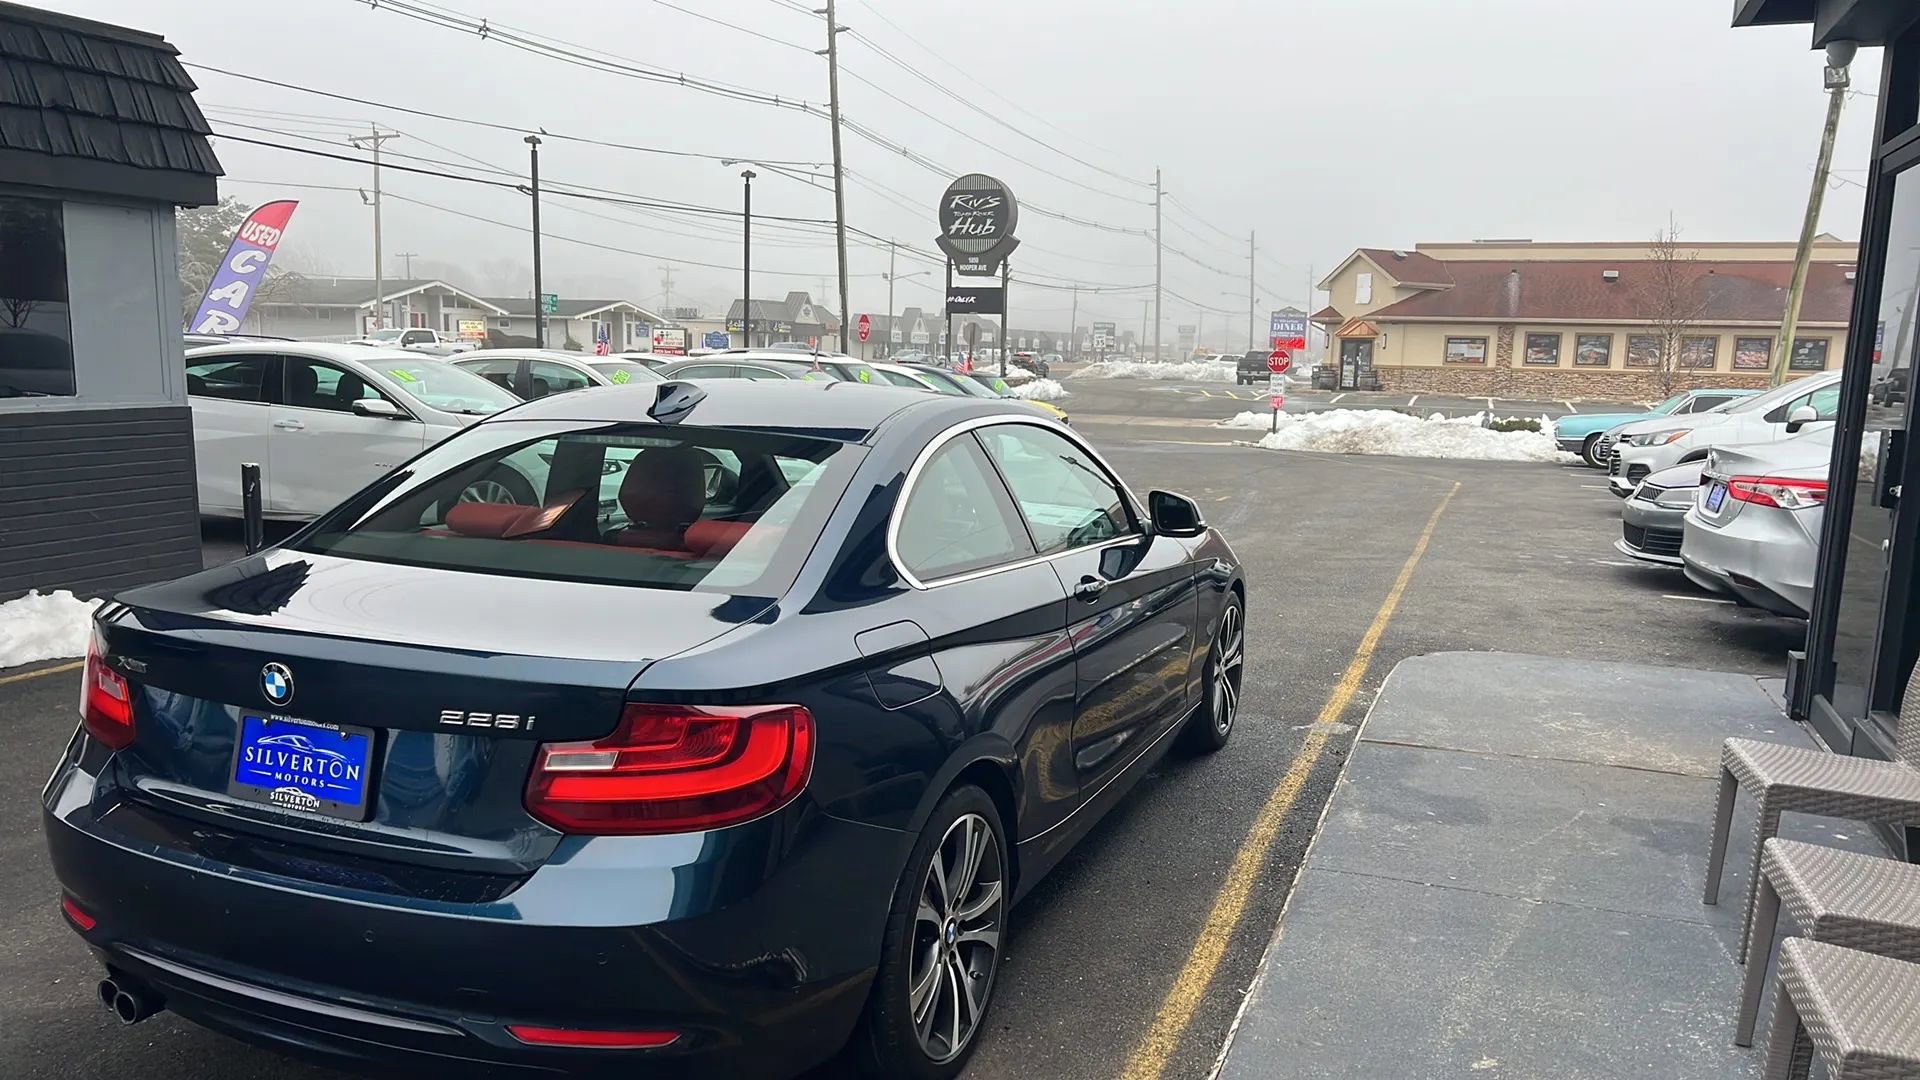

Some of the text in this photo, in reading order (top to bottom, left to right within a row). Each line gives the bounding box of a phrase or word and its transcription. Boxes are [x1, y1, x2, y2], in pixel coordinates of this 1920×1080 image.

[949, 194, 1001, 210] Riv's
[241, 220, 281, 247] USED
[949, 216, 996, 236] Hub
[960, 264, 987, 272] HOOPER AVE
[1273, 322, 1304, 331] DINER
[1268, 357, 1289, 366] STOP
[245, 746, 360, 781] SILVERTON
[275, 771, 325, 788] MOTORS
[270, 791, 320, 809] SILVERTON
